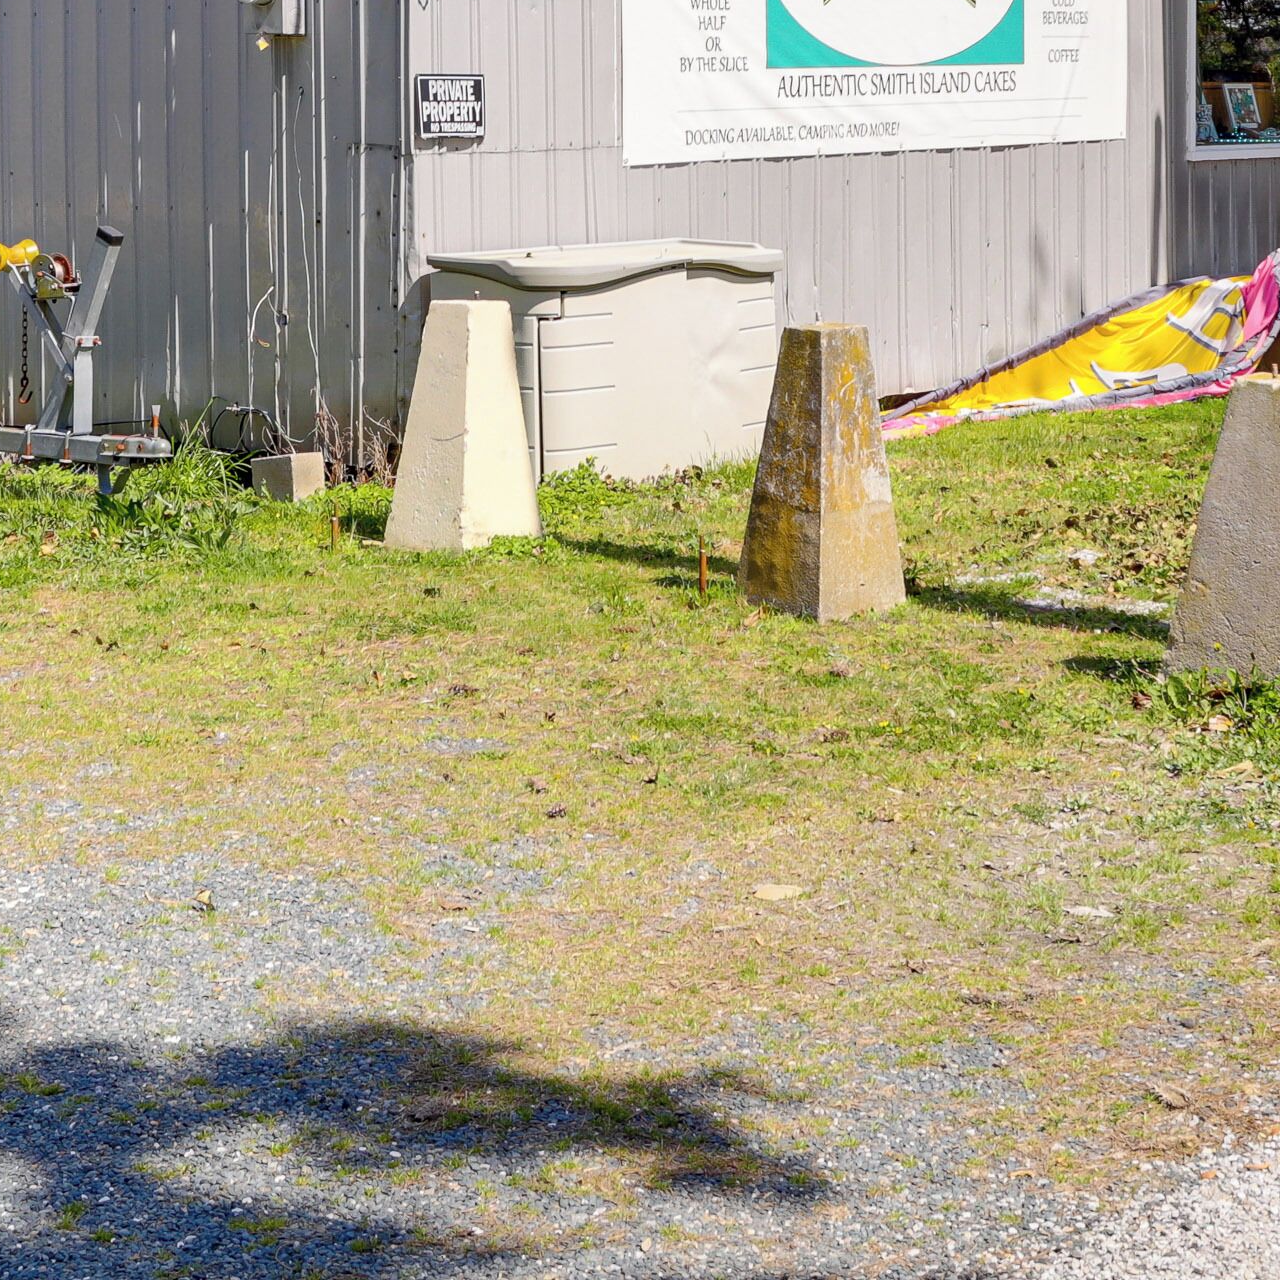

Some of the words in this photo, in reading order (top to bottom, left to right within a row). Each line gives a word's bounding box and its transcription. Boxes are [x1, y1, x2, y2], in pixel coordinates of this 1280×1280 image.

[698, 16, 726, 30] HALF
[1042, 11, 1089, 25] BEVERAGES
[705, 36, 722, 52] OR
[680, 57, 694, 72] BY
[696, 57, 717, 72] THE
[718, 56, 749, 72] SLICE
[1048, 49, 1079, 63] COFFEE
[428, 80, 475, 101] PRIVATE
[777, 74, 868, 98] AUTHENTIC
[870, 73, 916, 96] SMITH
[919, 71, 970, 94] ISLAND
[974, 70, 1016, 93] CAKES
[422, 101, 481, 122] PROPERTY
[685, 128, 734, 146] DOCKING
[737, 125, 796, 144] AVAILABLE,
[798, 123, 845, 141] CAMPING
[846, 123, 868, 138] AND
[869, 121, 900, 137] MORE!
